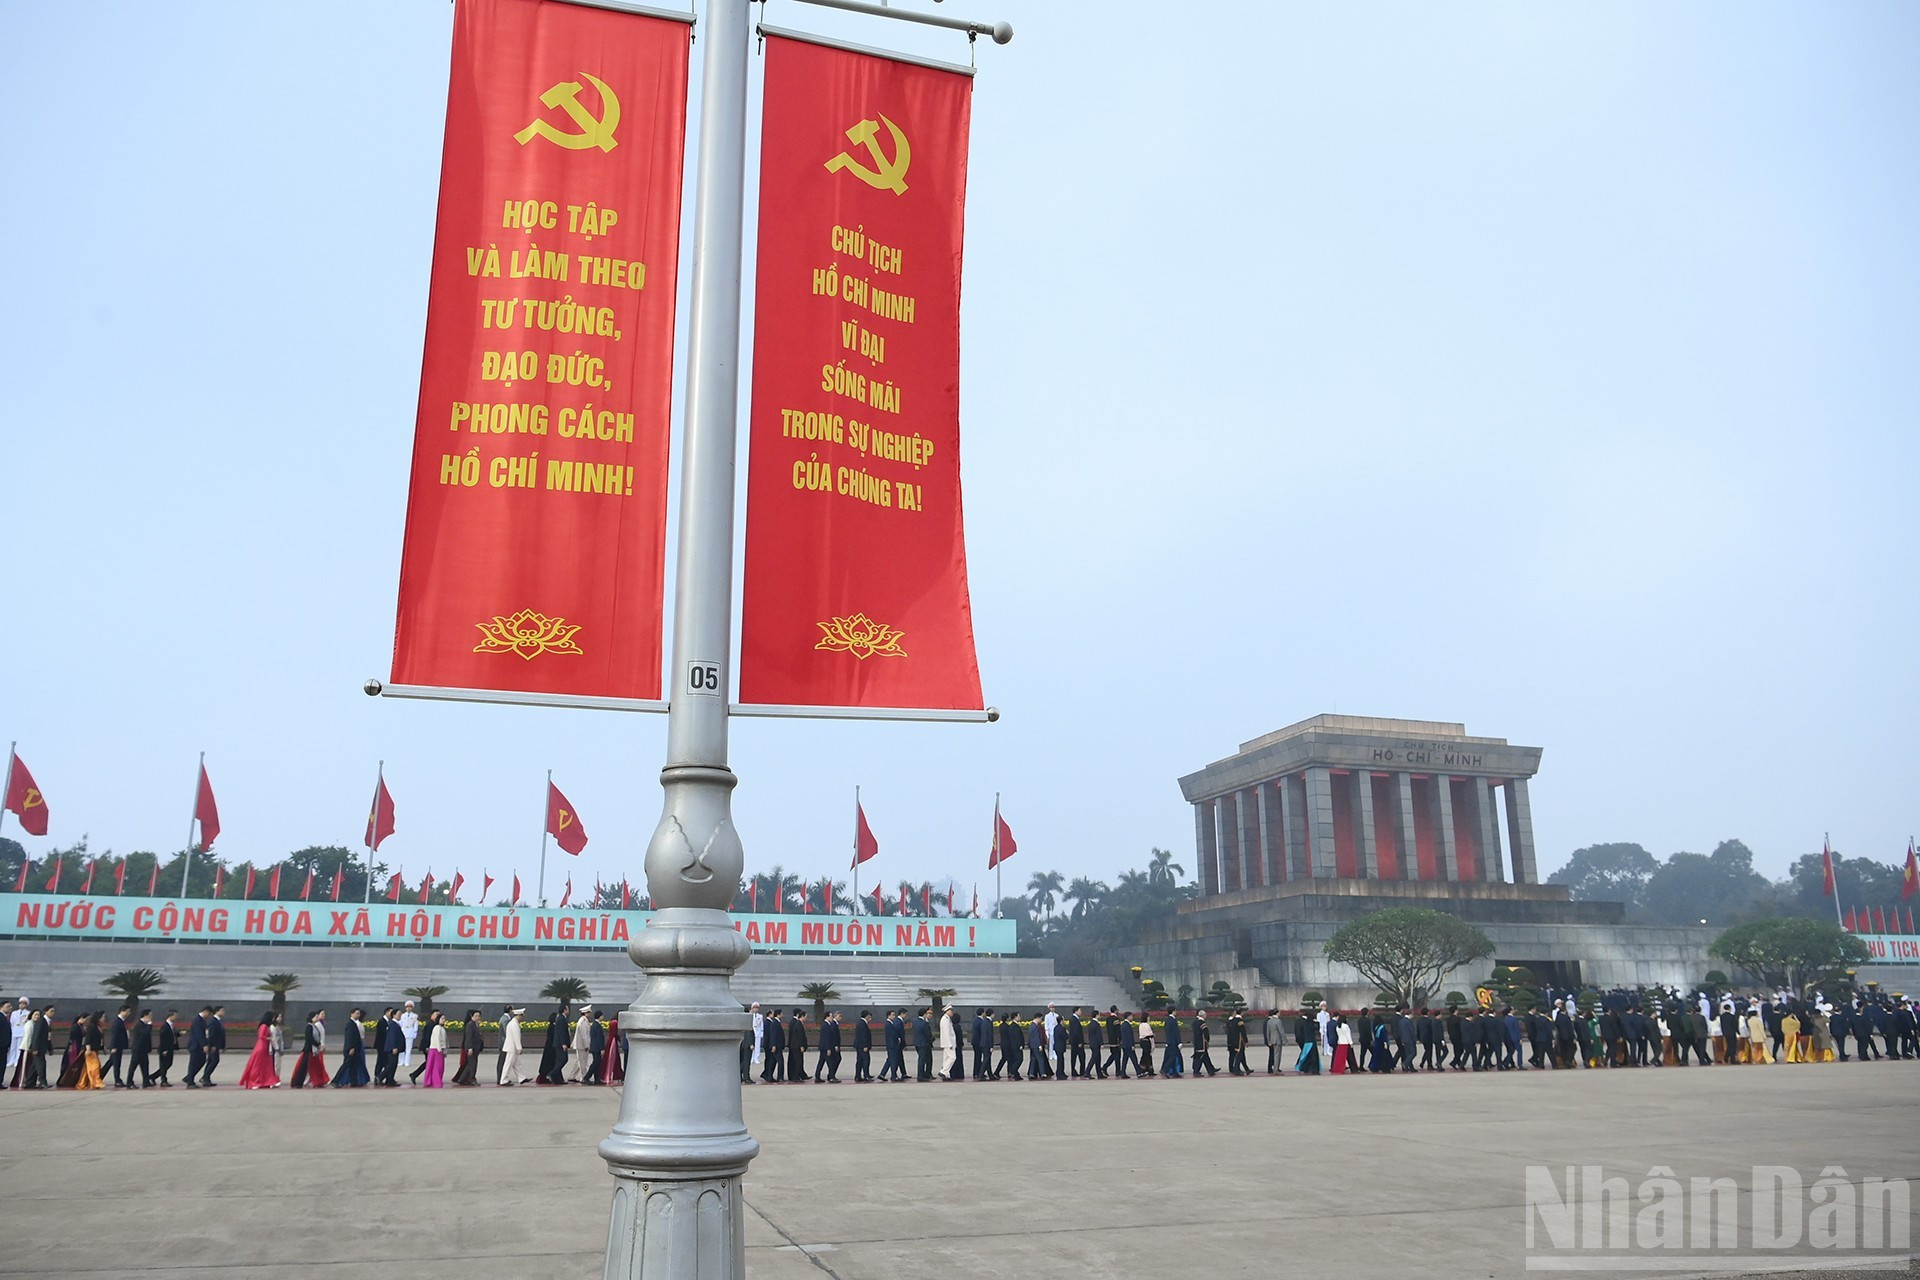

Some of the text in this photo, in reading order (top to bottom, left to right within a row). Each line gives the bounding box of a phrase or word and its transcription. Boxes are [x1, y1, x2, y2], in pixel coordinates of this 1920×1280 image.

[502, 200, 618, 240] HỌC TẬP
[467, 243, 646, 290] VÀ LÀM THEO
[831, 224, 902, 275] CHỦ TỊCH
[813, 263, 914, 323] HỒ CHÍ MINH
[482, 295, 621, 341] TƯ TƯỞNG,
[841, 318, 884, 366] VĨ ĐẠI
[482, 350, 611, 391] ĐẠO ĐỨC,
[822, 360, 900, 413] SỐNG MÃI
[450, 402, 634, 443] PHONG CÁCH
[782, 409, 934, 470] TRONG SỰ NGHIỆP
[440, 446, 633, 496] HỒ CHÍ MINH!
[793, 453, 921, 511] CỦA CHÚNG TA!
[691, 666, 718, 690] 05
[17, 901, 116, 930] NƯỚC
[133, 902, 229, 936] CỘNG
[245, 905, 313, 935] HÒA
[328, 907, 371, 936] XÃ
[386, 909, 442, 941] HỘI
[457, 908, 521, 939] CHỦ
[534, 913, 630, 941] NGHĨA
[735, 921, 788, 945] AM
[801, 919, 883, 946] MUÔN
[896, 922, 956, 947] NĂM
[1868, 936, 1919, 960] HỦ TỊCH
